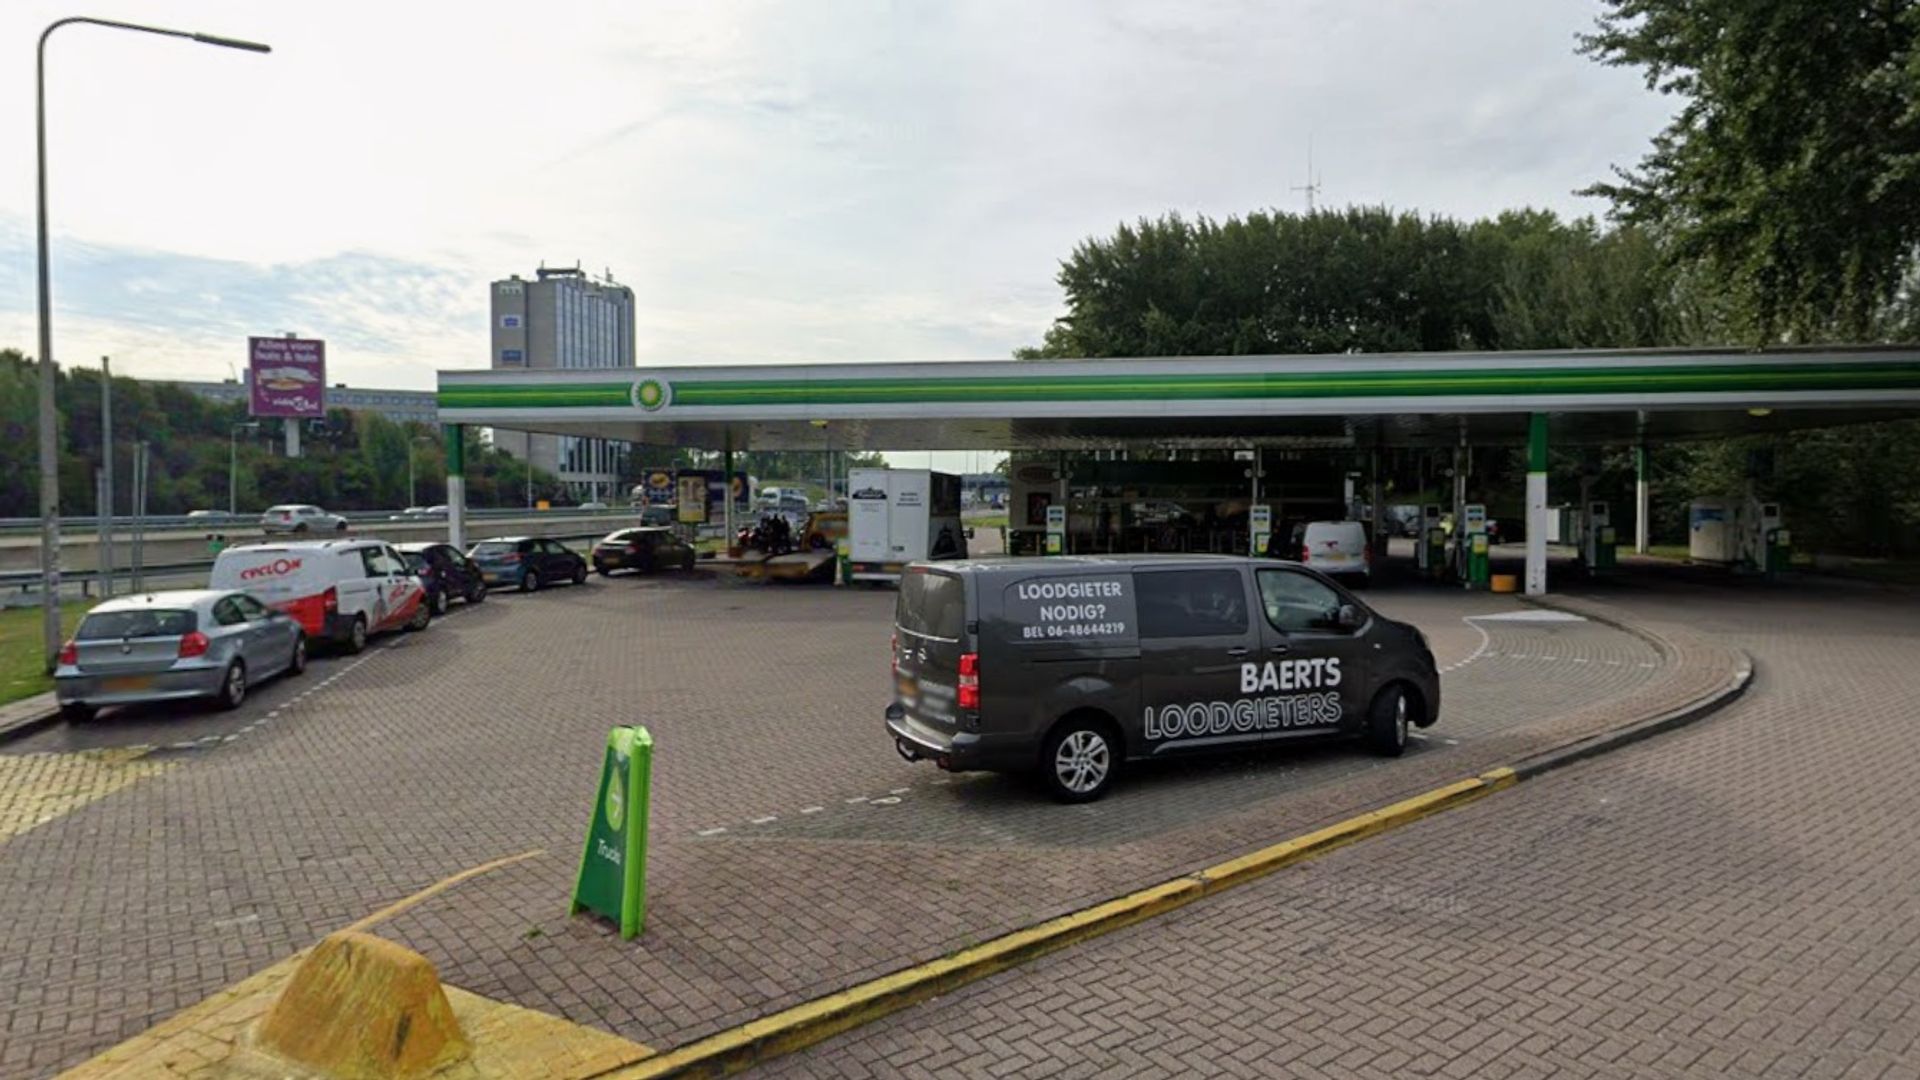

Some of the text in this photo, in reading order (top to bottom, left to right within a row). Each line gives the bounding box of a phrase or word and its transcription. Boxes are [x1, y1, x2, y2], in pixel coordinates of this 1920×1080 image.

[1018, 581, 1122, 600] LOODGIETER
[1040, 604, 1106, 621] NODIG?
[1023, 622, 1125, 638] BEL 06-48644219
[1240, 657, 1342, 693] BAERTS
[1144, 691, 1342, 740] LOODGIETERS
